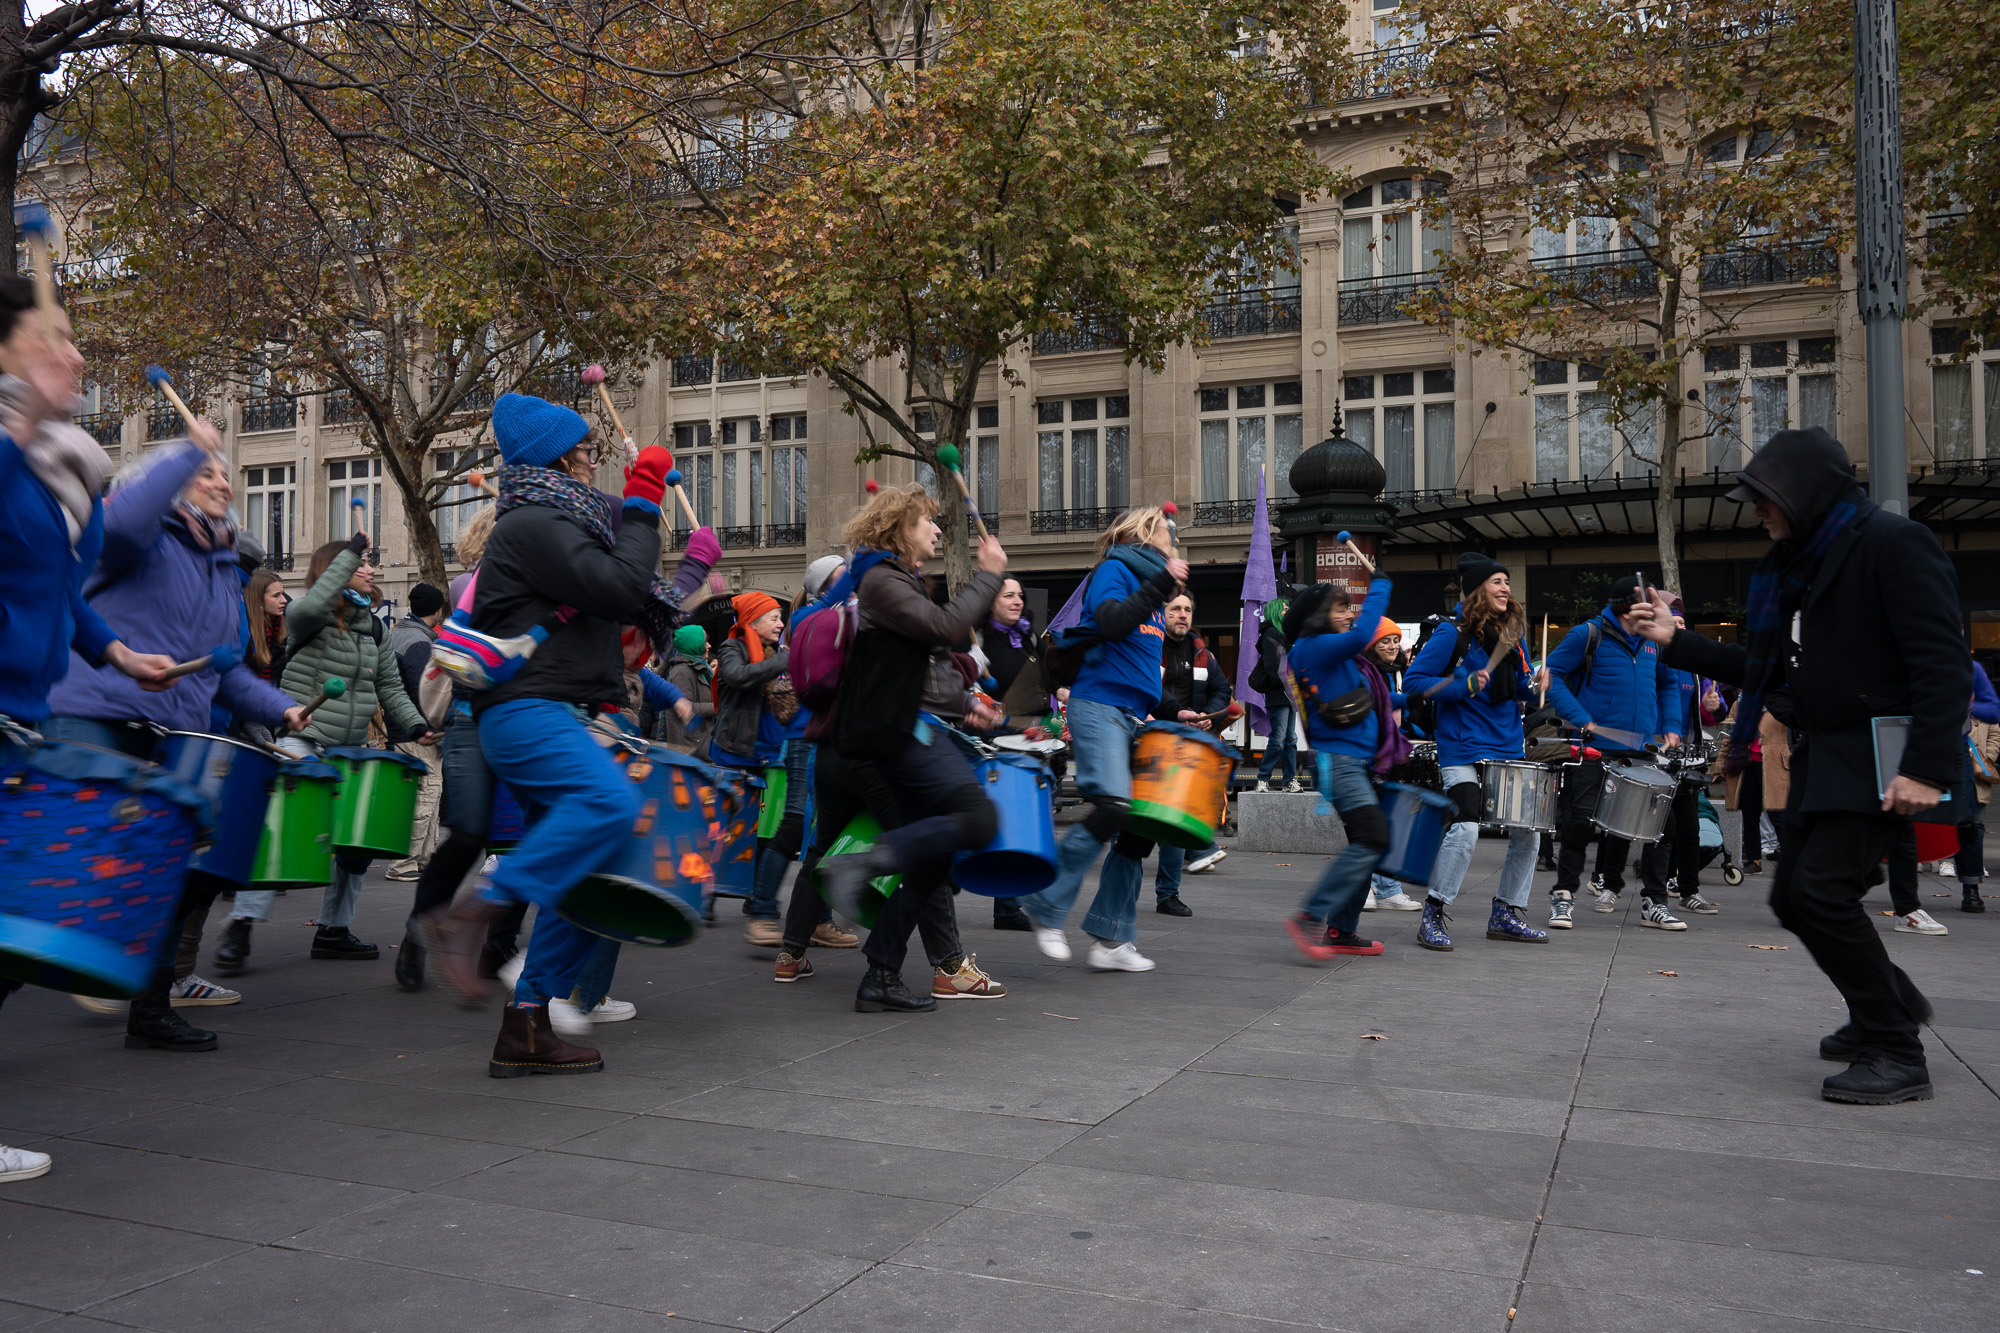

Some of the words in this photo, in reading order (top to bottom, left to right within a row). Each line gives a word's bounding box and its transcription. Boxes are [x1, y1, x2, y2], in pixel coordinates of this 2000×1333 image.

[1332, 578, 1349, 586] STONE
[1344, 586, 1368, 594] ANTHIMOS
[708, 599, 733, 612] CROW
